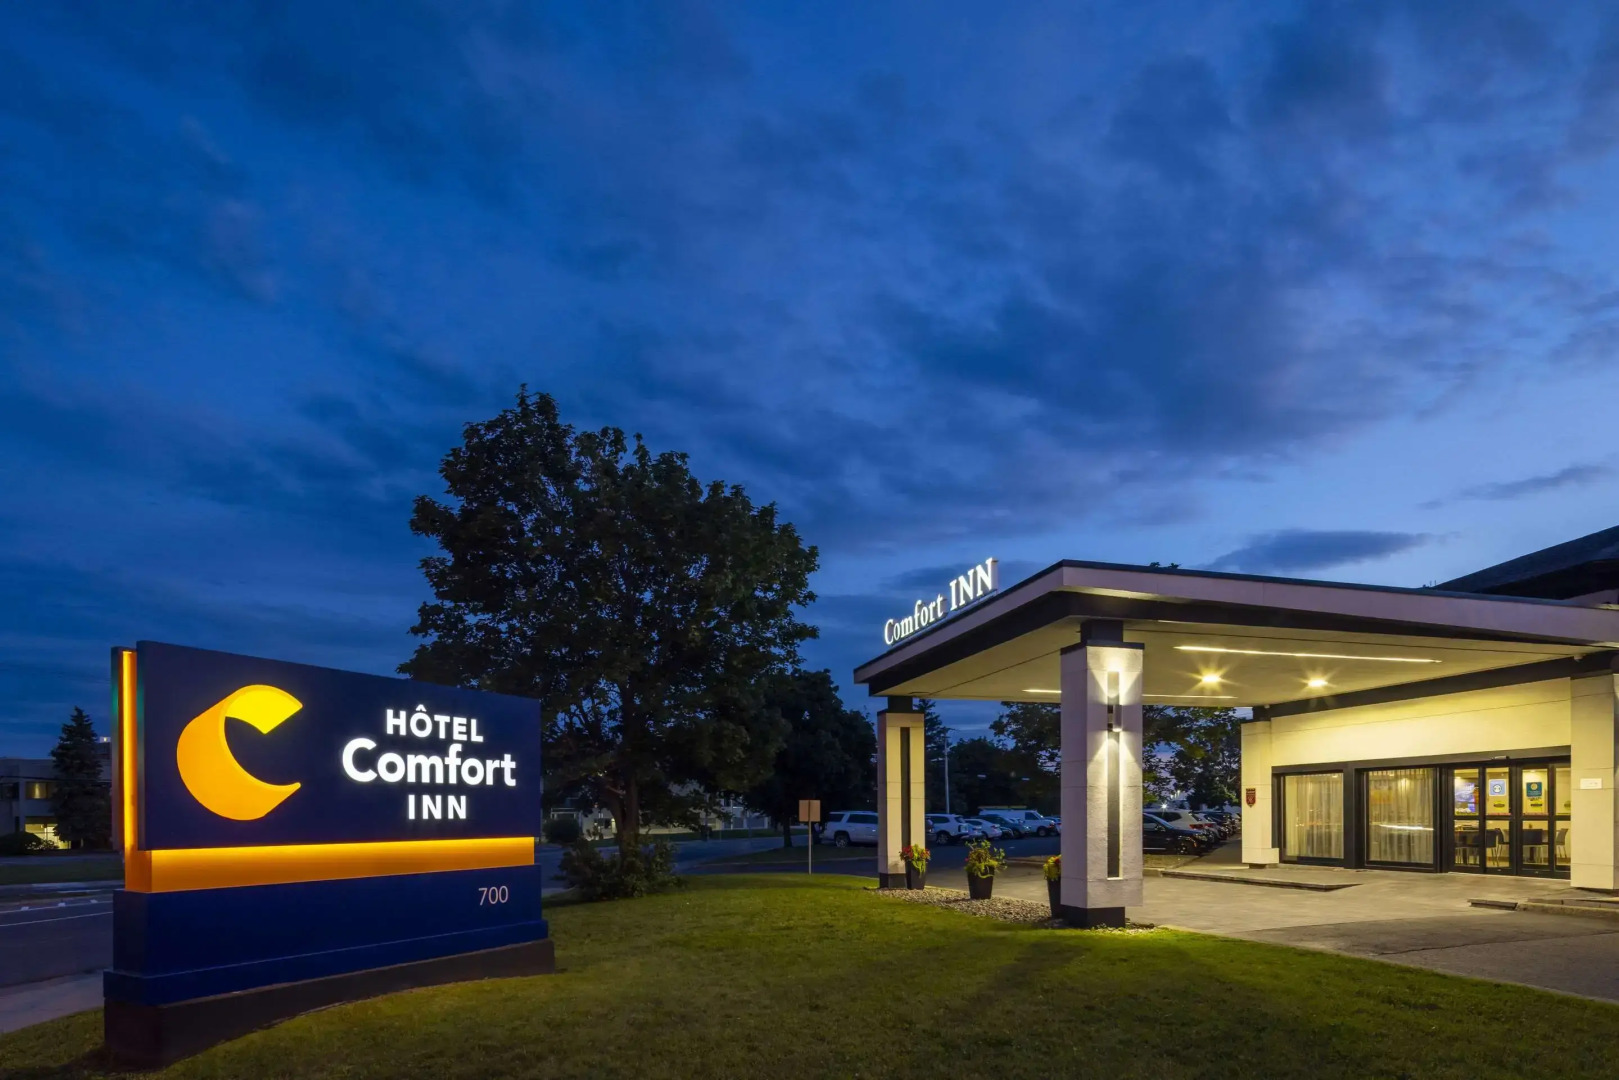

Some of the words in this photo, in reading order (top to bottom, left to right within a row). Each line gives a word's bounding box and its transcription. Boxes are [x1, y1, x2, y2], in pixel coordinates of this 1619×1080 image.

[884, 594, 944, 645] Comfort
[949, 557, 993, 611] INN
[385, 704, 484, 743] HÔTEL
[341, 737, 517, 787] Comfort
[408, 794, 467, 820] INN
[478, 885, 509, 906] 700
